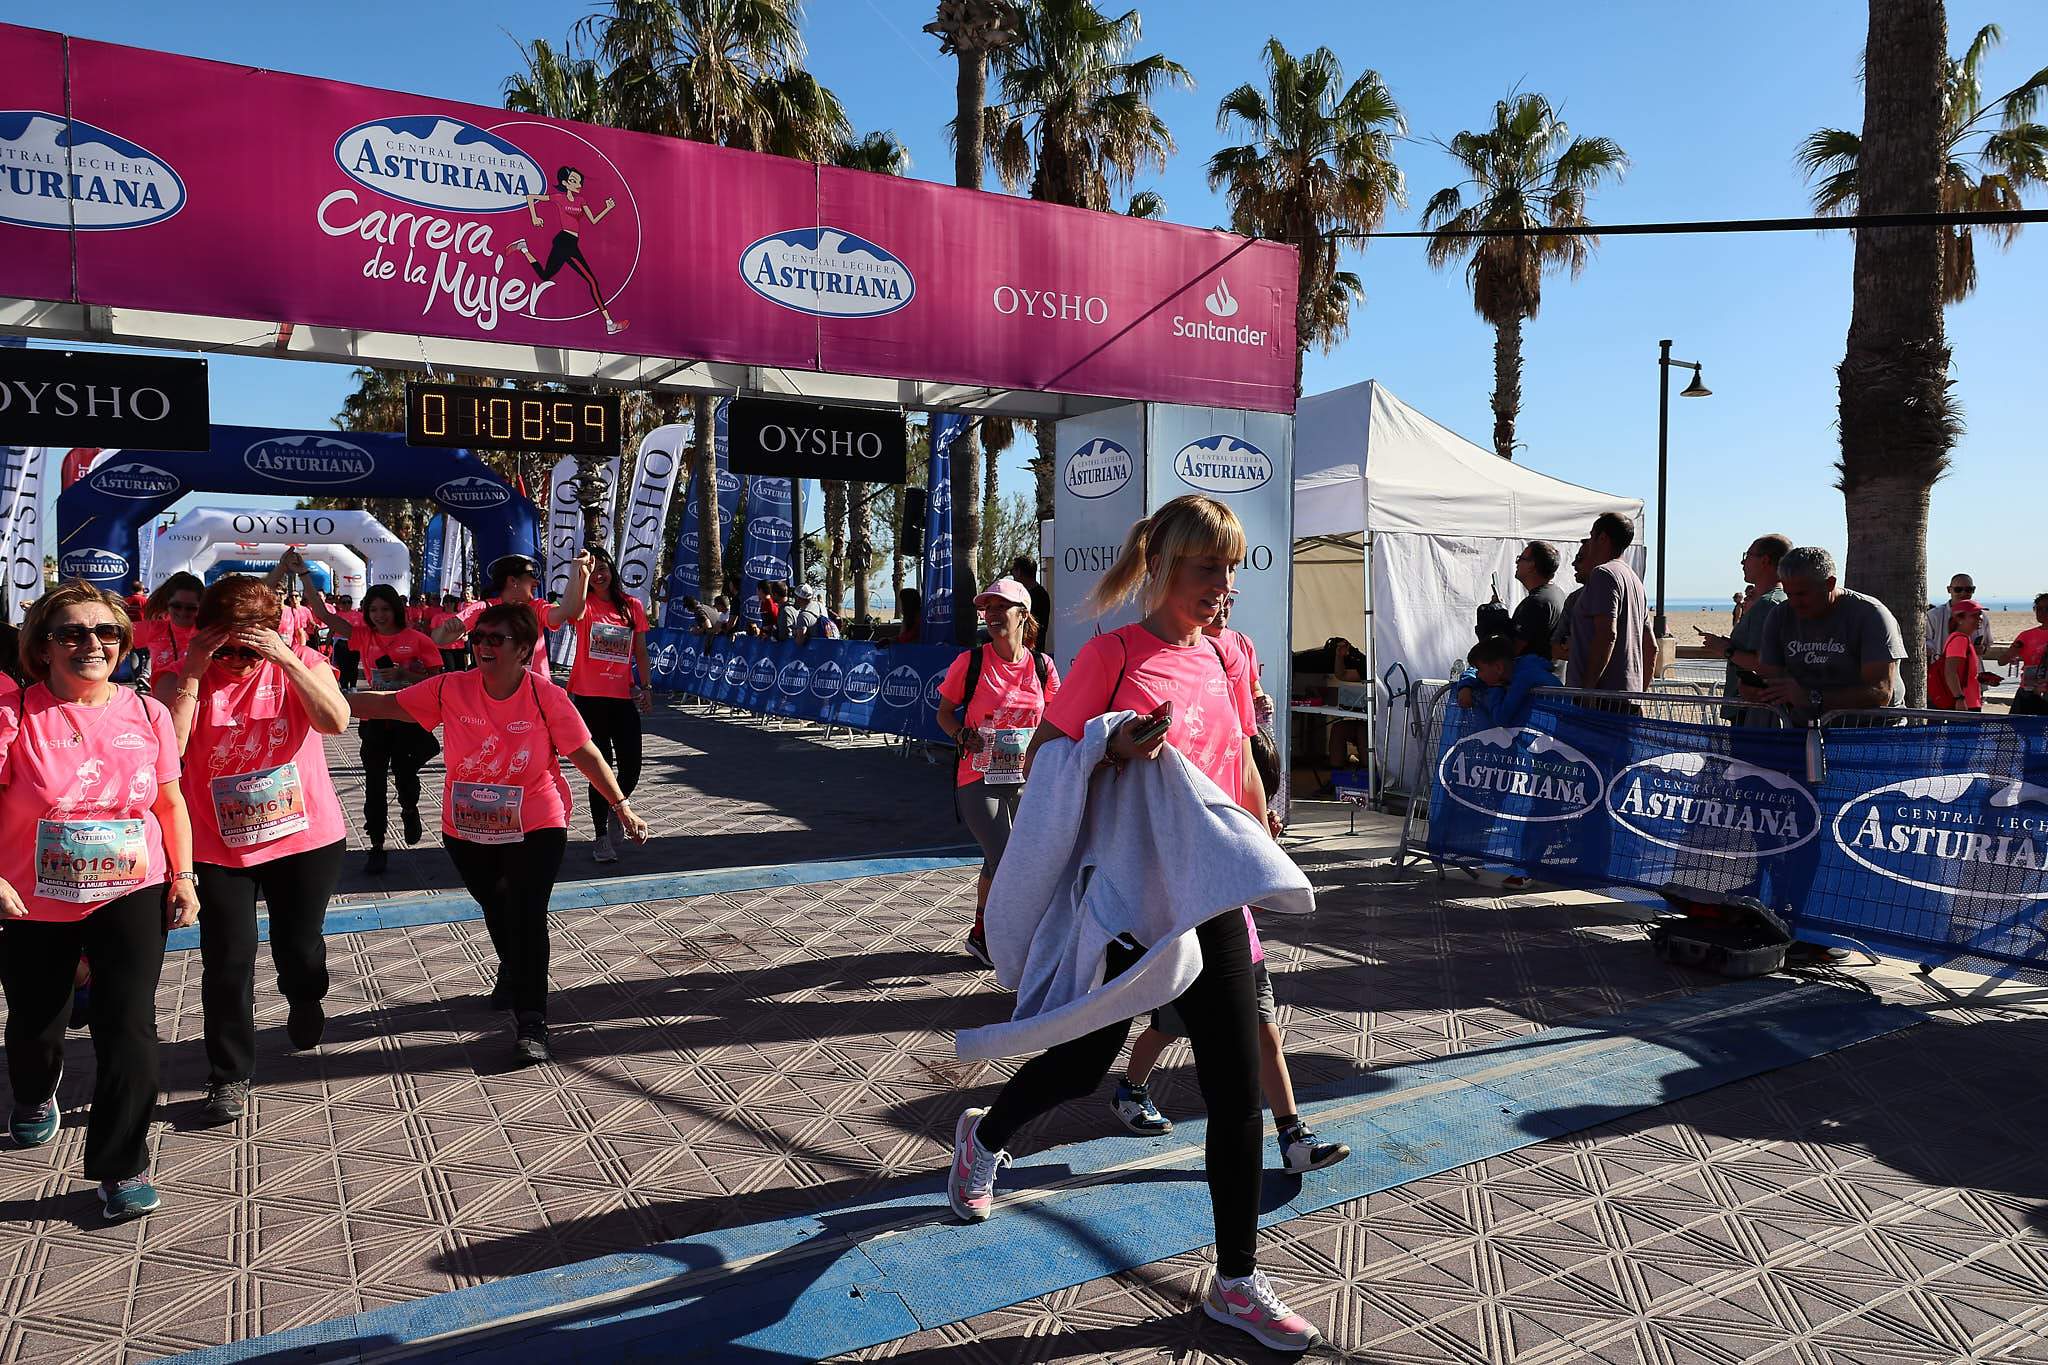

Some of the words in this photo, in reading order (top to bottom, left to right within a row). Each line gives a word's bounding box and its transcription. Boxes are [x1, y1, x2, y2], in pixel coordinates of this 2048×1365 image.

[0, 148, 55, 165] TRAL
[386, 140, 454, 160] CENTRAL
[460, 151, 525, 170] LECHERA
[353, 138, 529, 197] ASTURIANA
[317, 189, 495, 256] Carrera
[782, 253, 837, 267] CENTRAL
[842, 261, 897, 275] LECHERA
[754, 252, 903, 300] ASTURIANA
[363, 247, 396, 280] de
[403, 249, 427, 285] la
[422, 252, 556, 331] Mujer
[993, 286, 1109, 324] OYSHO
[1172, 315, 1267, 346] Santander
[0, 380, 171, 421] YSHO
[423, 394, 604, 443] 01:08:59
[759, 424, 883, 459] OYSHO
[255, 448, 365, 473] ASTURIANA
[1181, 454, 1266, 481] ASTURIANA
[96, 474, 173, 491] ASTURIANA
[1068, 463, 1127, 487] ASTURIANA
[442, 488, 506, 501] ASTURIANA
[755, 484, 792, 499] ASTURIA
[233, 514, 335, 536] OYSHO
[168, 534, 202, 542] OYSHO
[63, 559, 125, 574] ASTURIANA
[1064, 545, 1122, 573] OYSH
[747, 564, 789, 578] ASTURIANA
[883, 681, 918, 697] ASTURIANA
[1475, 753, 1527, 767] CENTRAL
[1452, 751, 1588, 806] ASTURIANA
[1654, 777, 1723, 797] CENTRAL
[1617, 776, 1800, 839] ASTURIANA
[1898, 806, 1985, 825] CENTRAL
[72, 857, 115, 872] 016
[46, 887, 80, 899] OYSHO
[77, 881, 87, 889] LA
